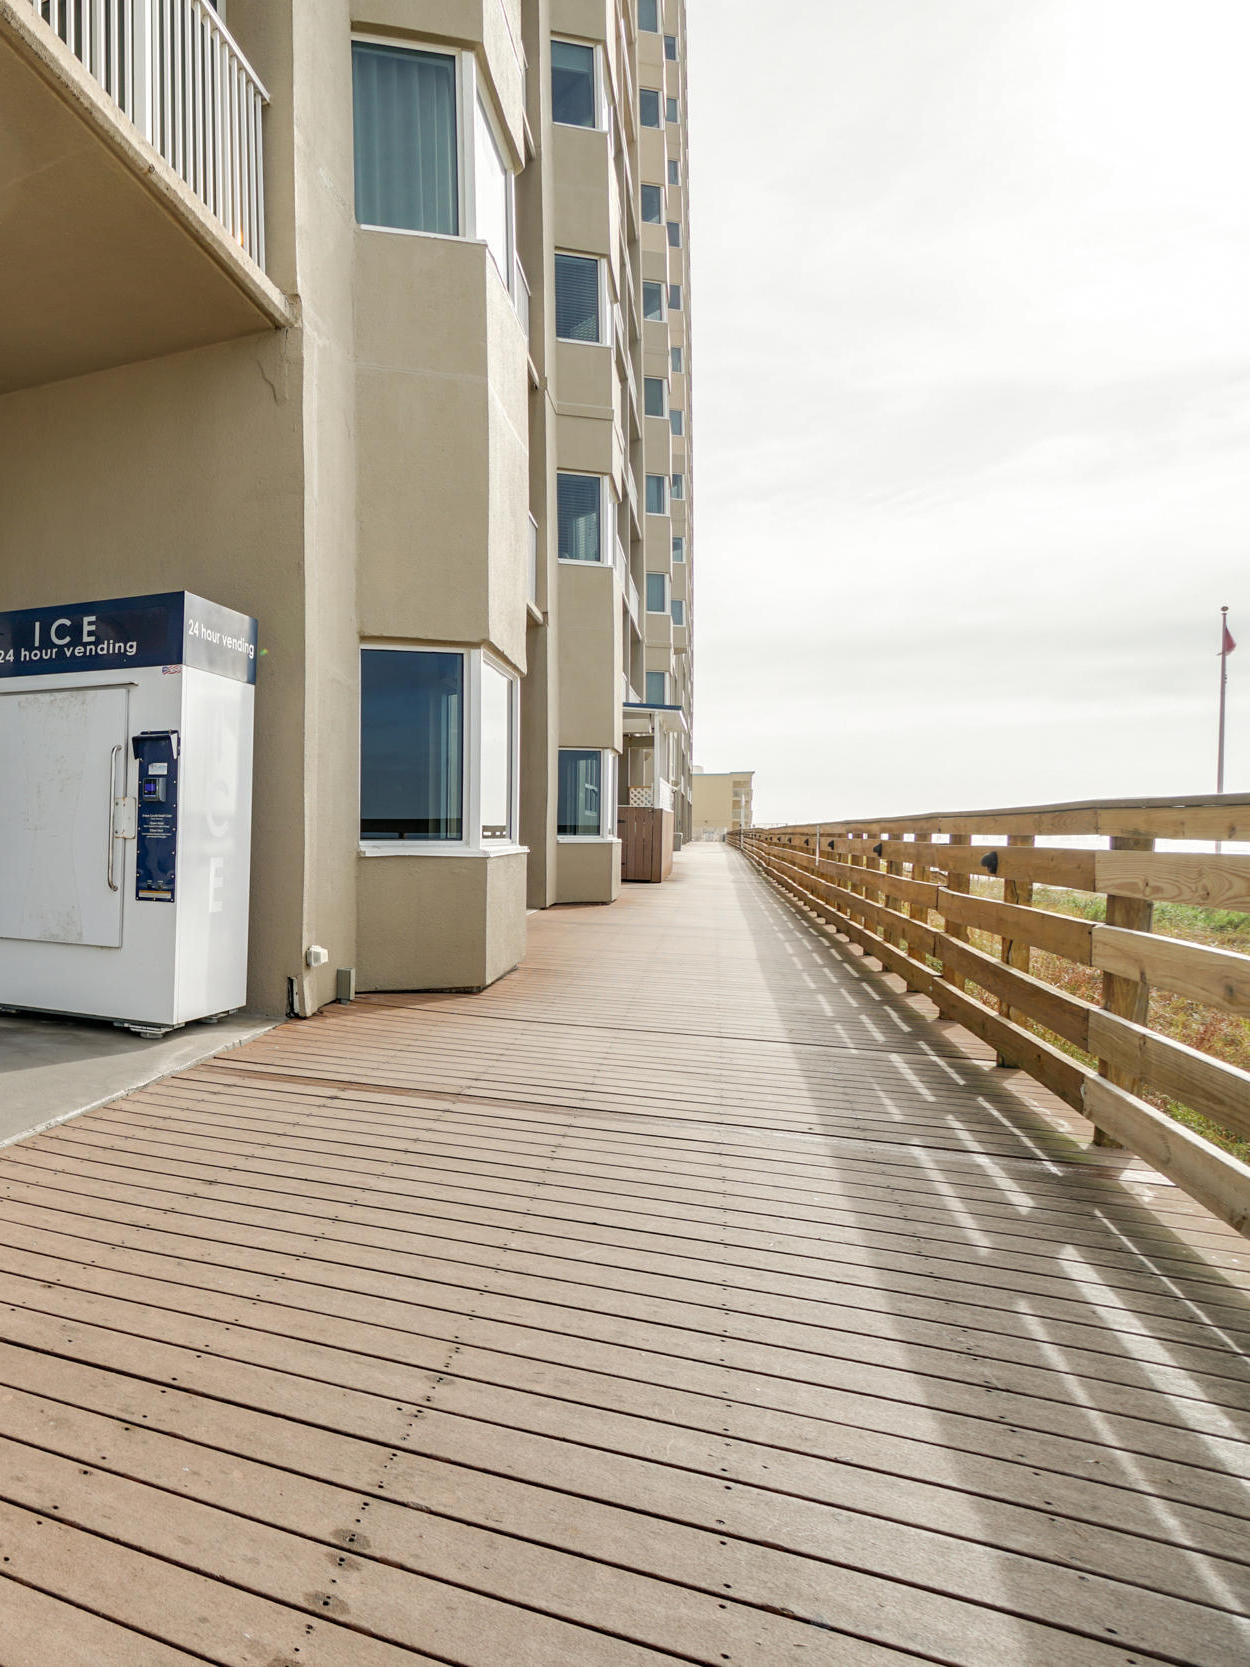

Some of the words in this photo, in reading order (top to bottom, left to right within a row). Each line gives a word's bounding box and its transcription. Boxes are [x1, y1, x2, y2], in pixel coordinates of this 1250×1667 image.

[33, 615, 98, 647] ICE
[188, 619, 200, 637] 24
[200, 623, 222, 647] hour
[222, 631, 255, 659] vending
[20, 646, 59, 663] hour
[63, 639, 138, 659] vending
